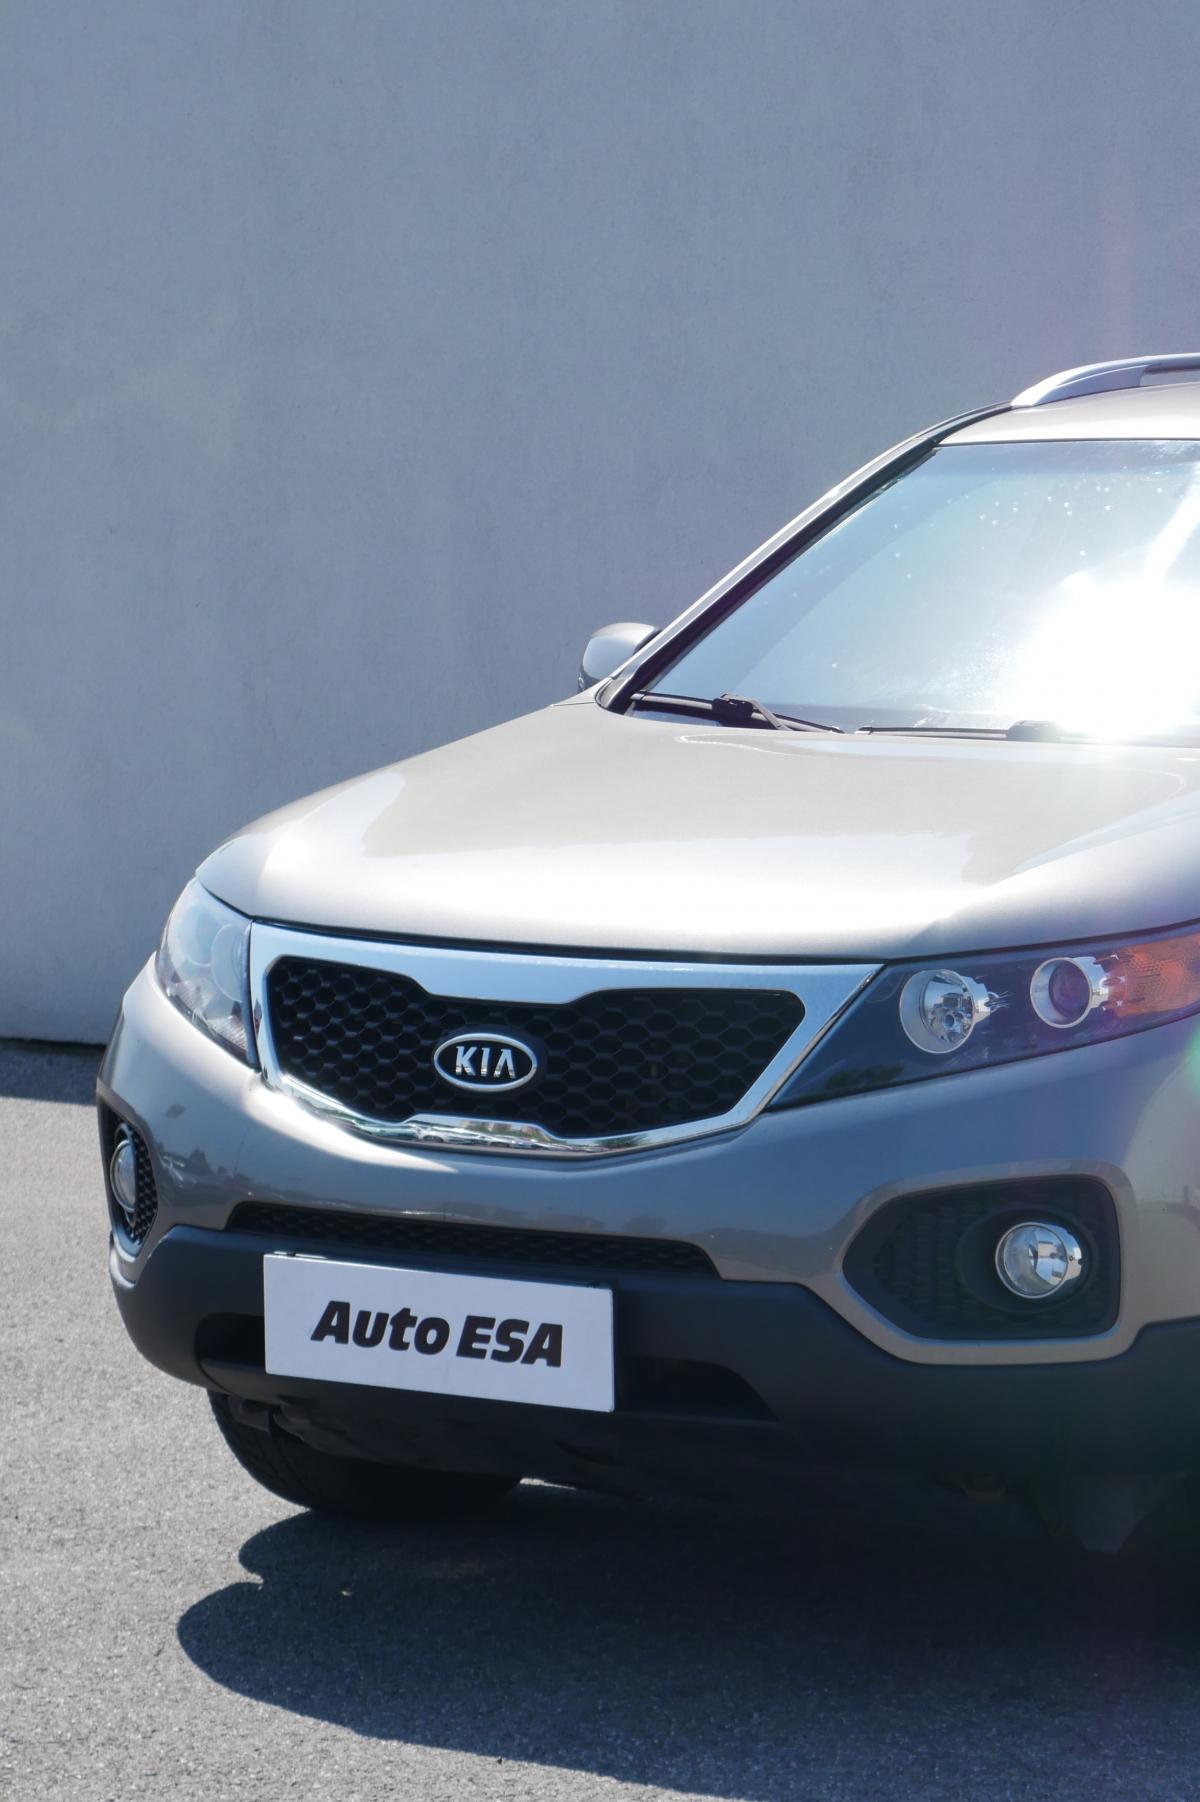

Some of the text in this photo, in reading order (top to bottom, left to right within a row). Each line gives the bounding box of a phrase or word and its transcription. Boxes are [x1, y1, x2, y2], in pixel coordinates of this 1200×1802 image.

[455, 1045, 516, 1079] KIA
[310, 1300, 563, 1368] Auto ESA
